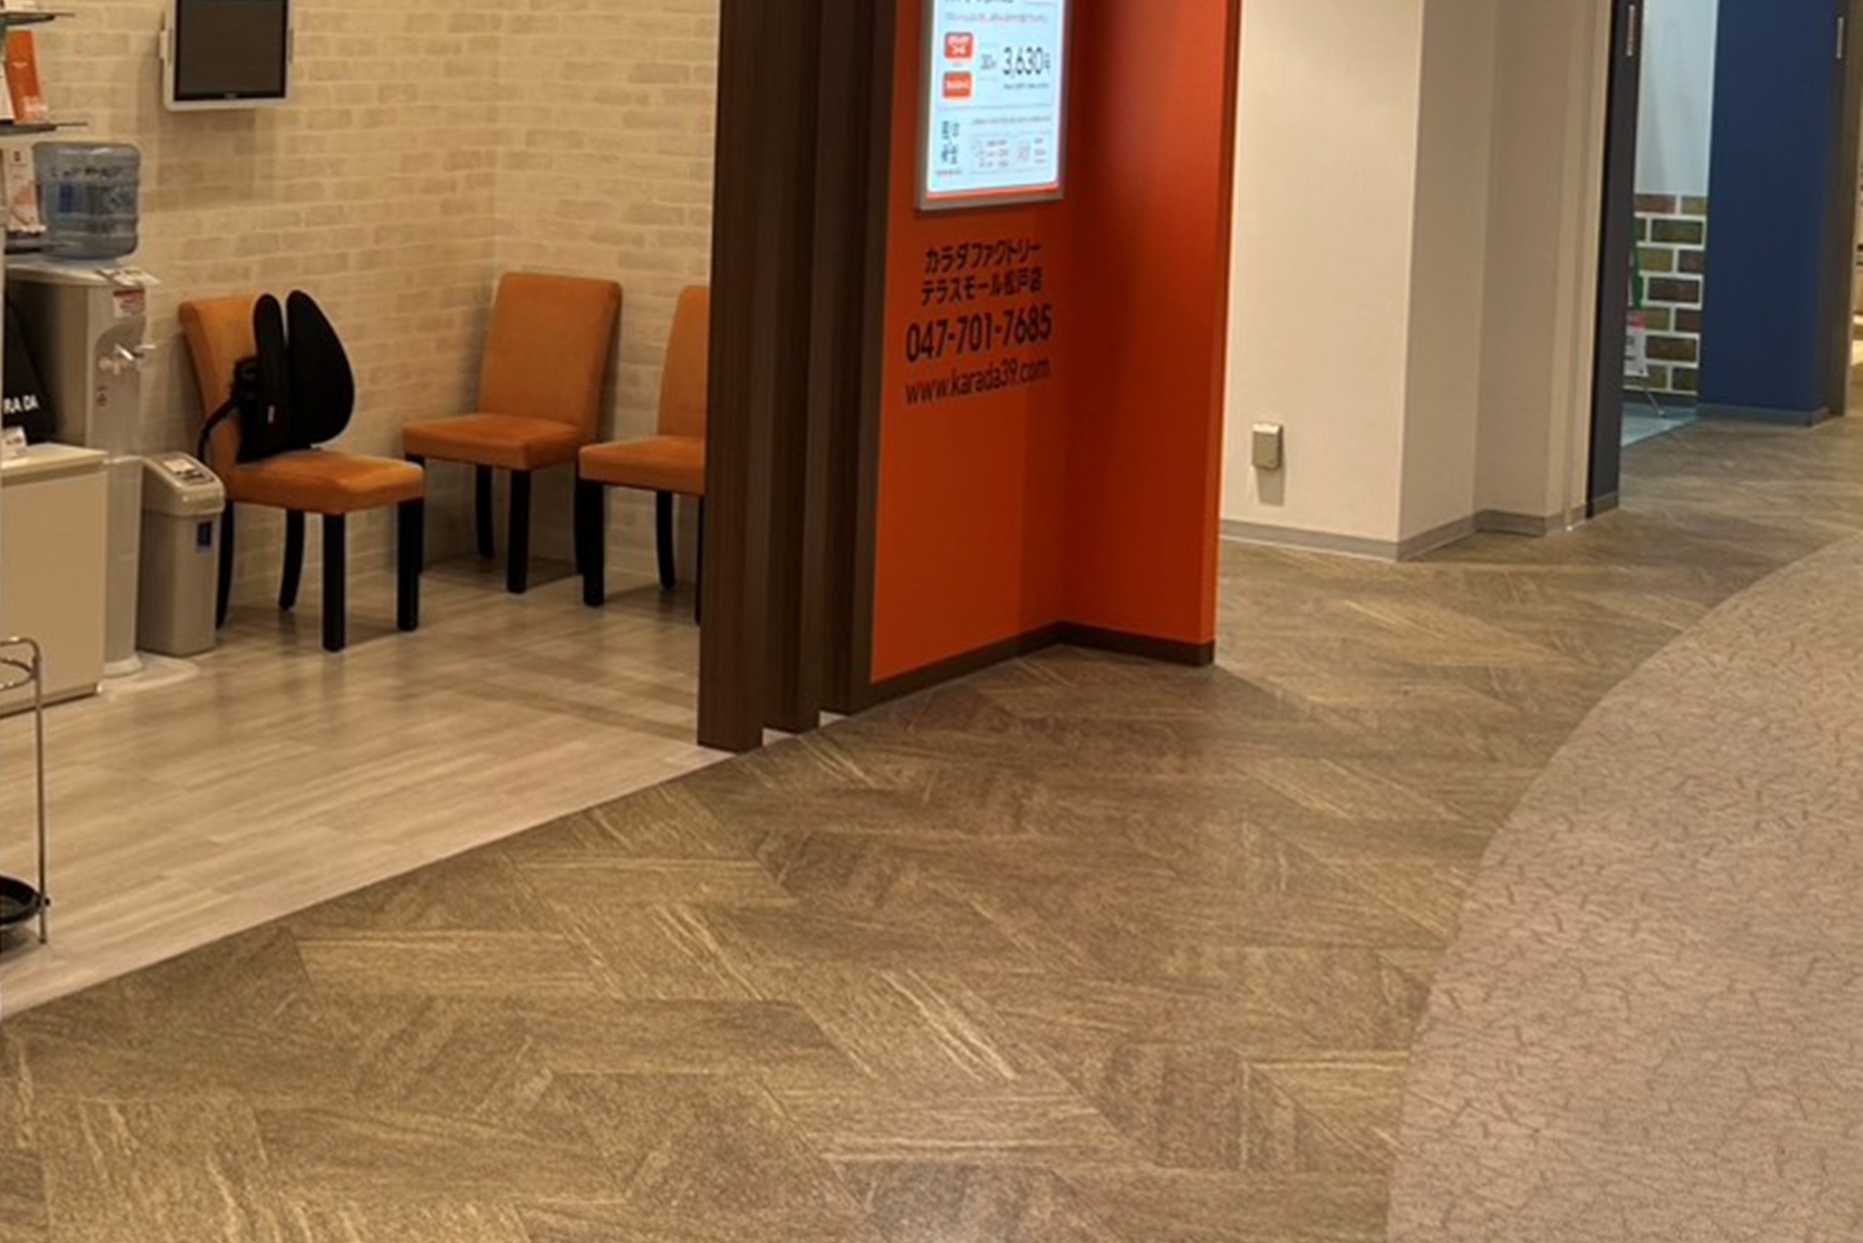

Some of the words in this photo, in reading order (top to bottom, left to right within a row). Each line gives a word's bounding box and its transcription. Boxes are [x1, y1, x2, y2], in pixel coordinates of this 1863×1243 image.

[925, 239, 1043, 274] カラダファクトリー
[921, 267, 1043, 306] テラスモール松戸店
[906, 304, 1052, 363] 047-701-7685
[906, 357, 1052, 404] www.karada39.com
